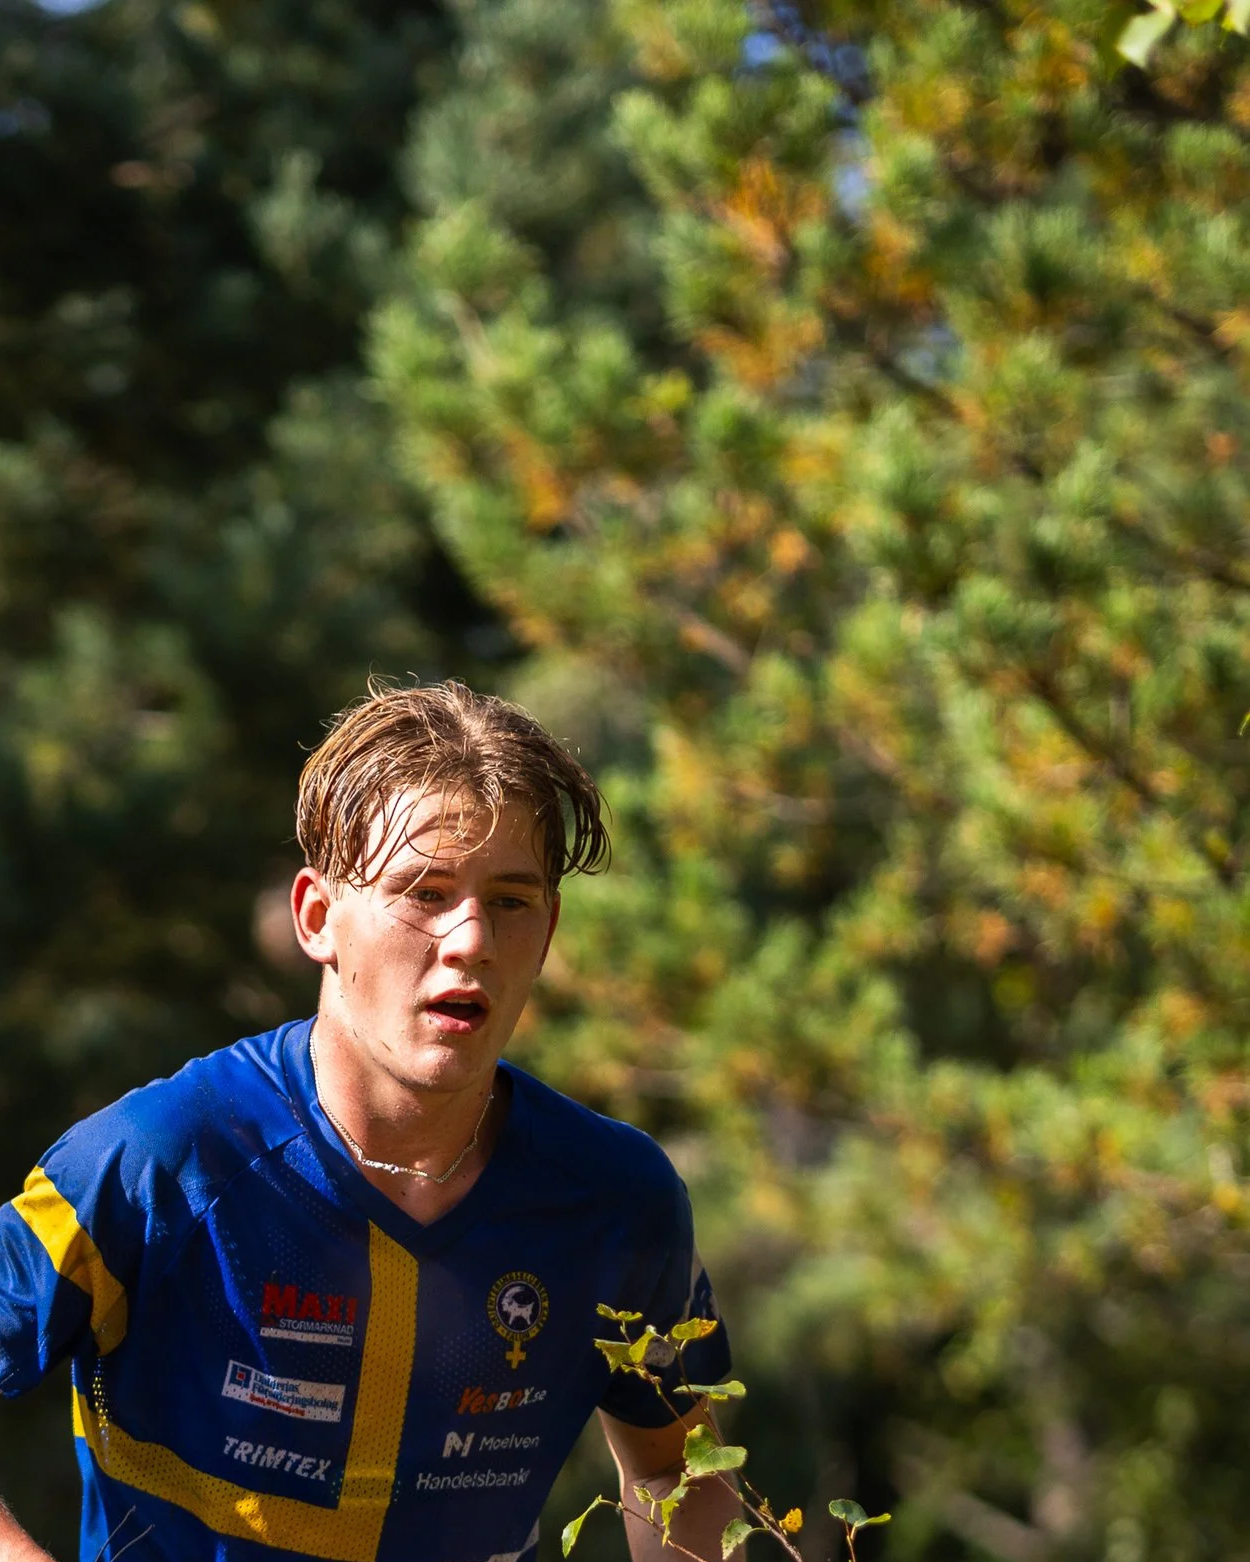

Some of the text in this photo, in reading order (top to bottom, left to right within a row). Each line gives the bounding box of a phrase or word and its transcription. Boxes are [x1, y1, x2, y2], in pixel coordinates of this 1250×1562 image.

[262, 1282, 358, 1325] MAXI
[279, 1318, 355, 1335] STORMARKNAD
[478, 1433, 541, 1451] Moelven
[223, 1435, 333, 1481] TRIMTEX
